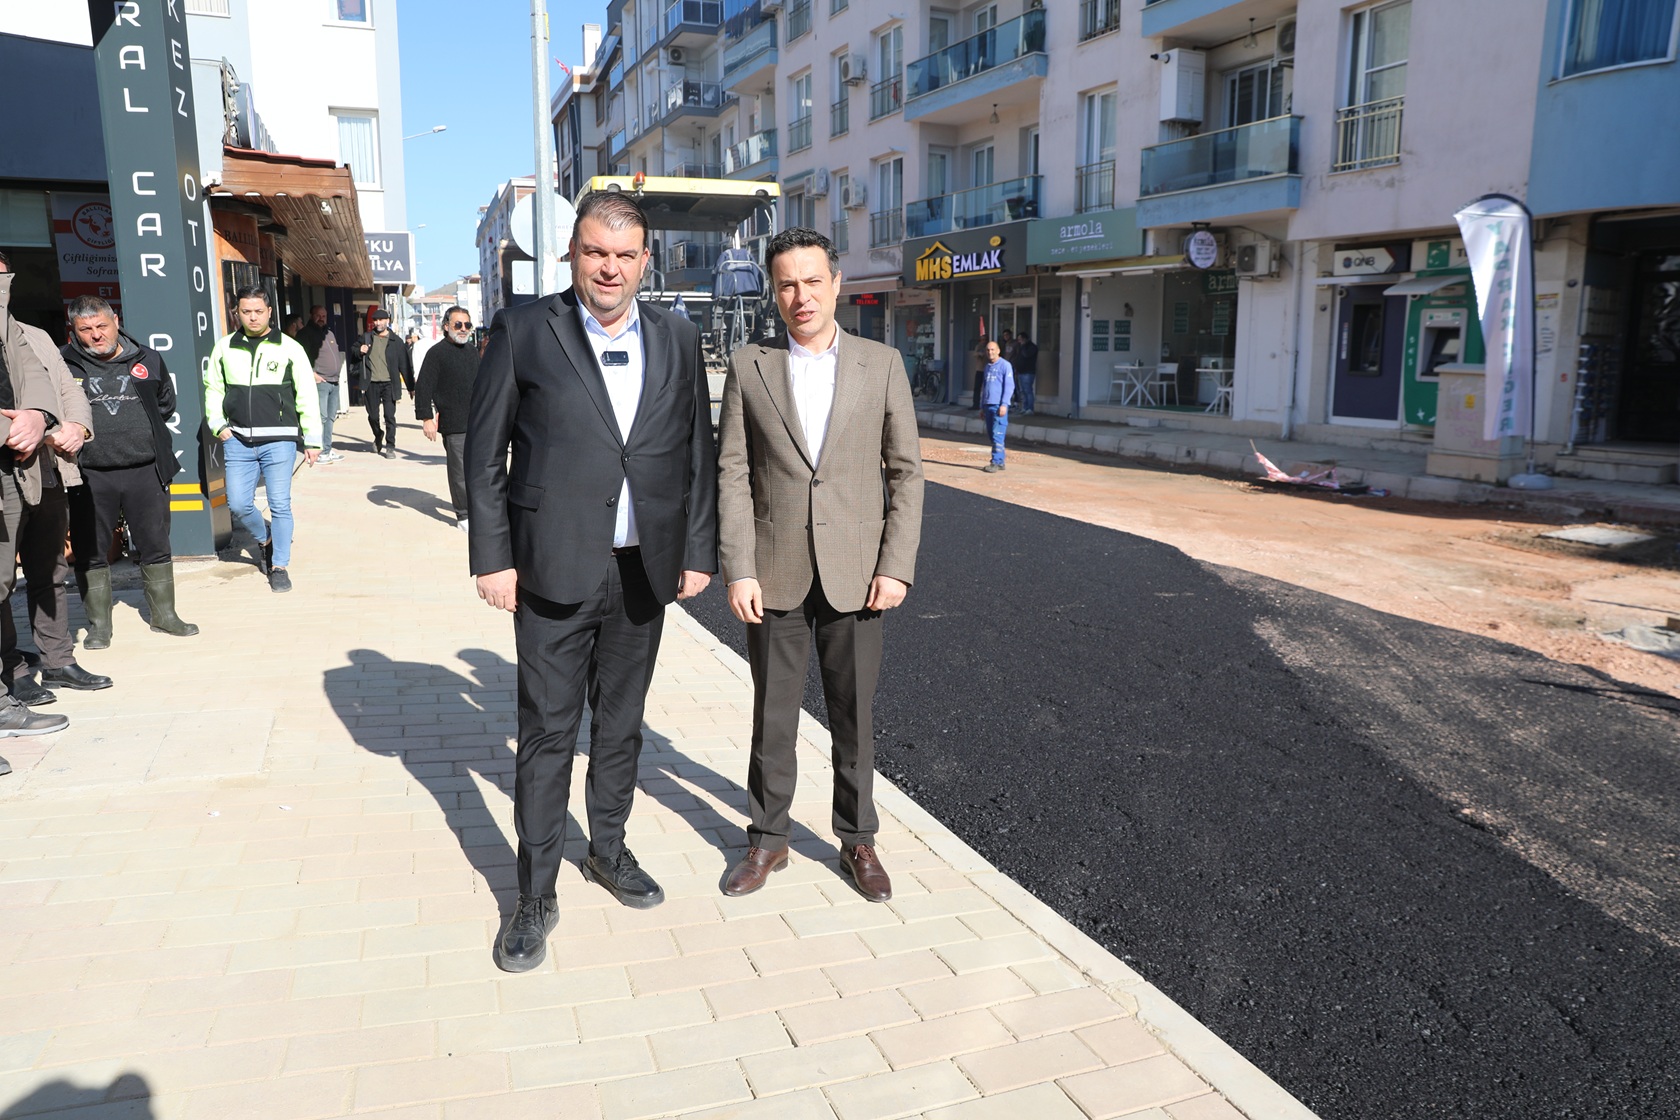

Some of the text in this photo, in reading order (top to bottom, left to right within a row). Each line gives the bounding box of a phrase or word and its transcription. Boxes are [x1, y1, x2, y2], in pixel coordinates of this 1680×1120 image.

[132, 172, 166, 277] CAR
[1060, 220, 1102, 238] armola
[365, 240, 393, 252] KU
[916, 249, 1001, 281] MHS EMLAK
[1354, 257, 1375, 267] QNB
[1208, 275, 1238, 290] arm
[99, 287, 113, 296] ET
